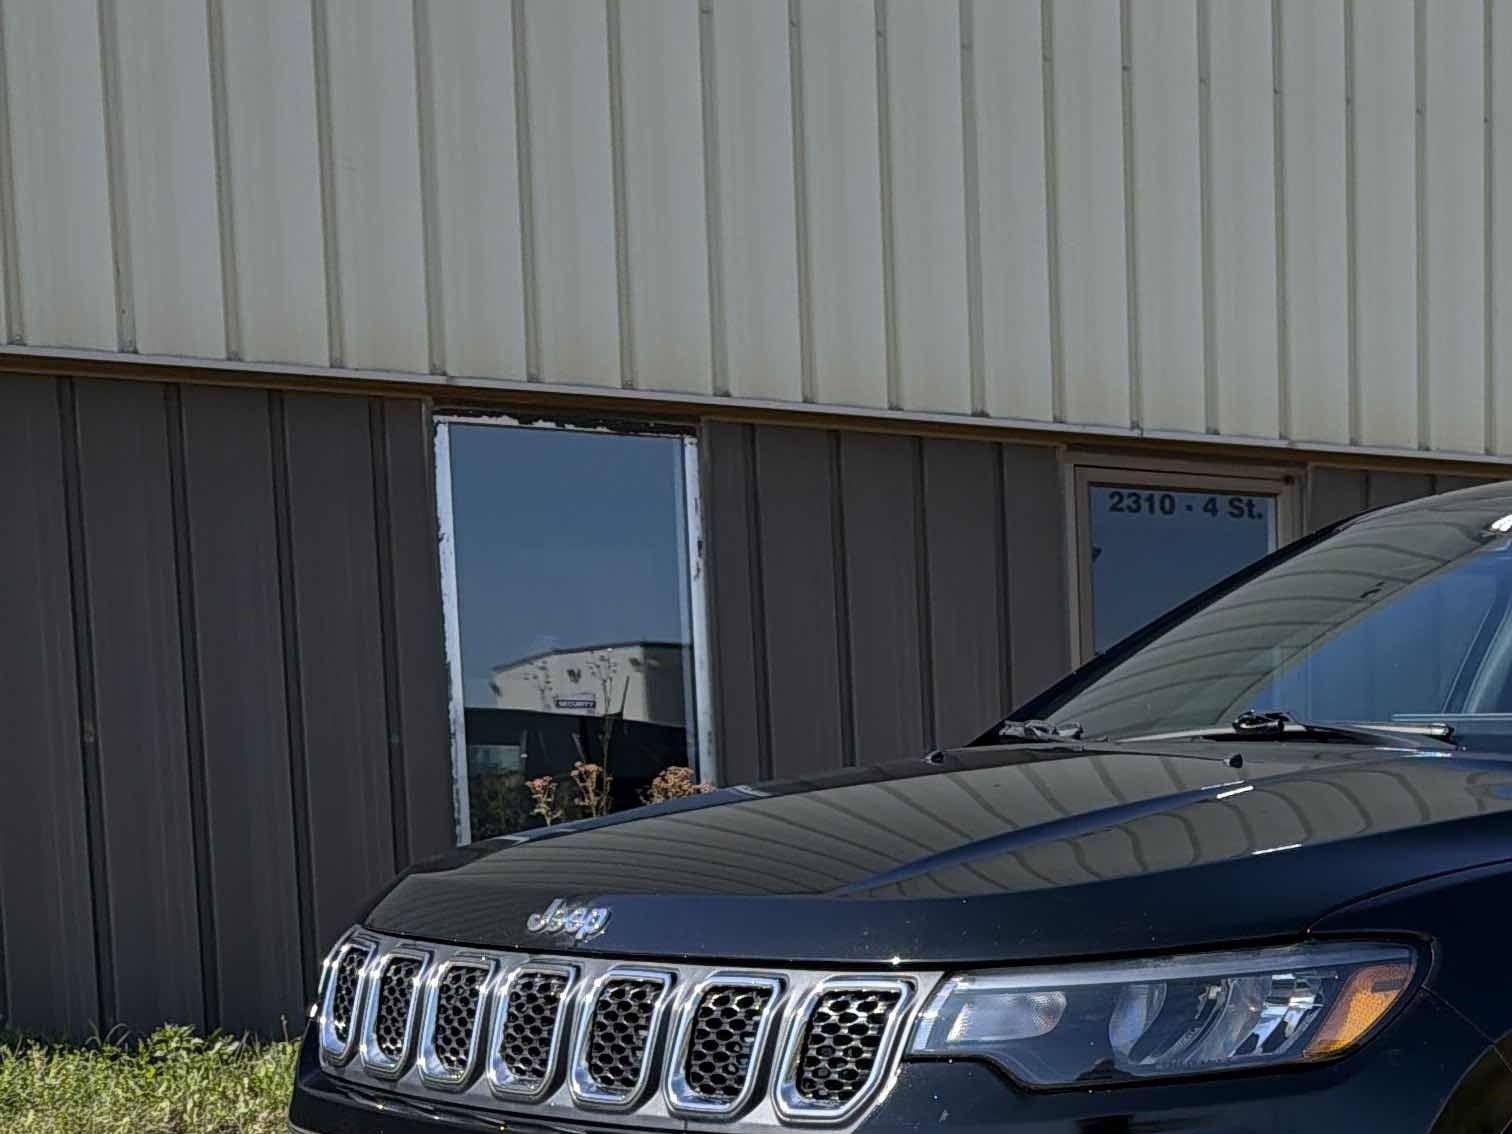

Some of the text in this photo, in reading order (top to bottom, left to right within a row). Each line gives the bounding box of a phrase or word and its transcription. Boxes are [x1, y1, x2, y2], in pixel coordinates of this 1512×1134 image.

[1108, 491, 1176, 515] 2310
[1203, 496, 1218, 517] 4
[1228, 497, 1263, 519] St.
[526, 898, 610, 941] Jeep
